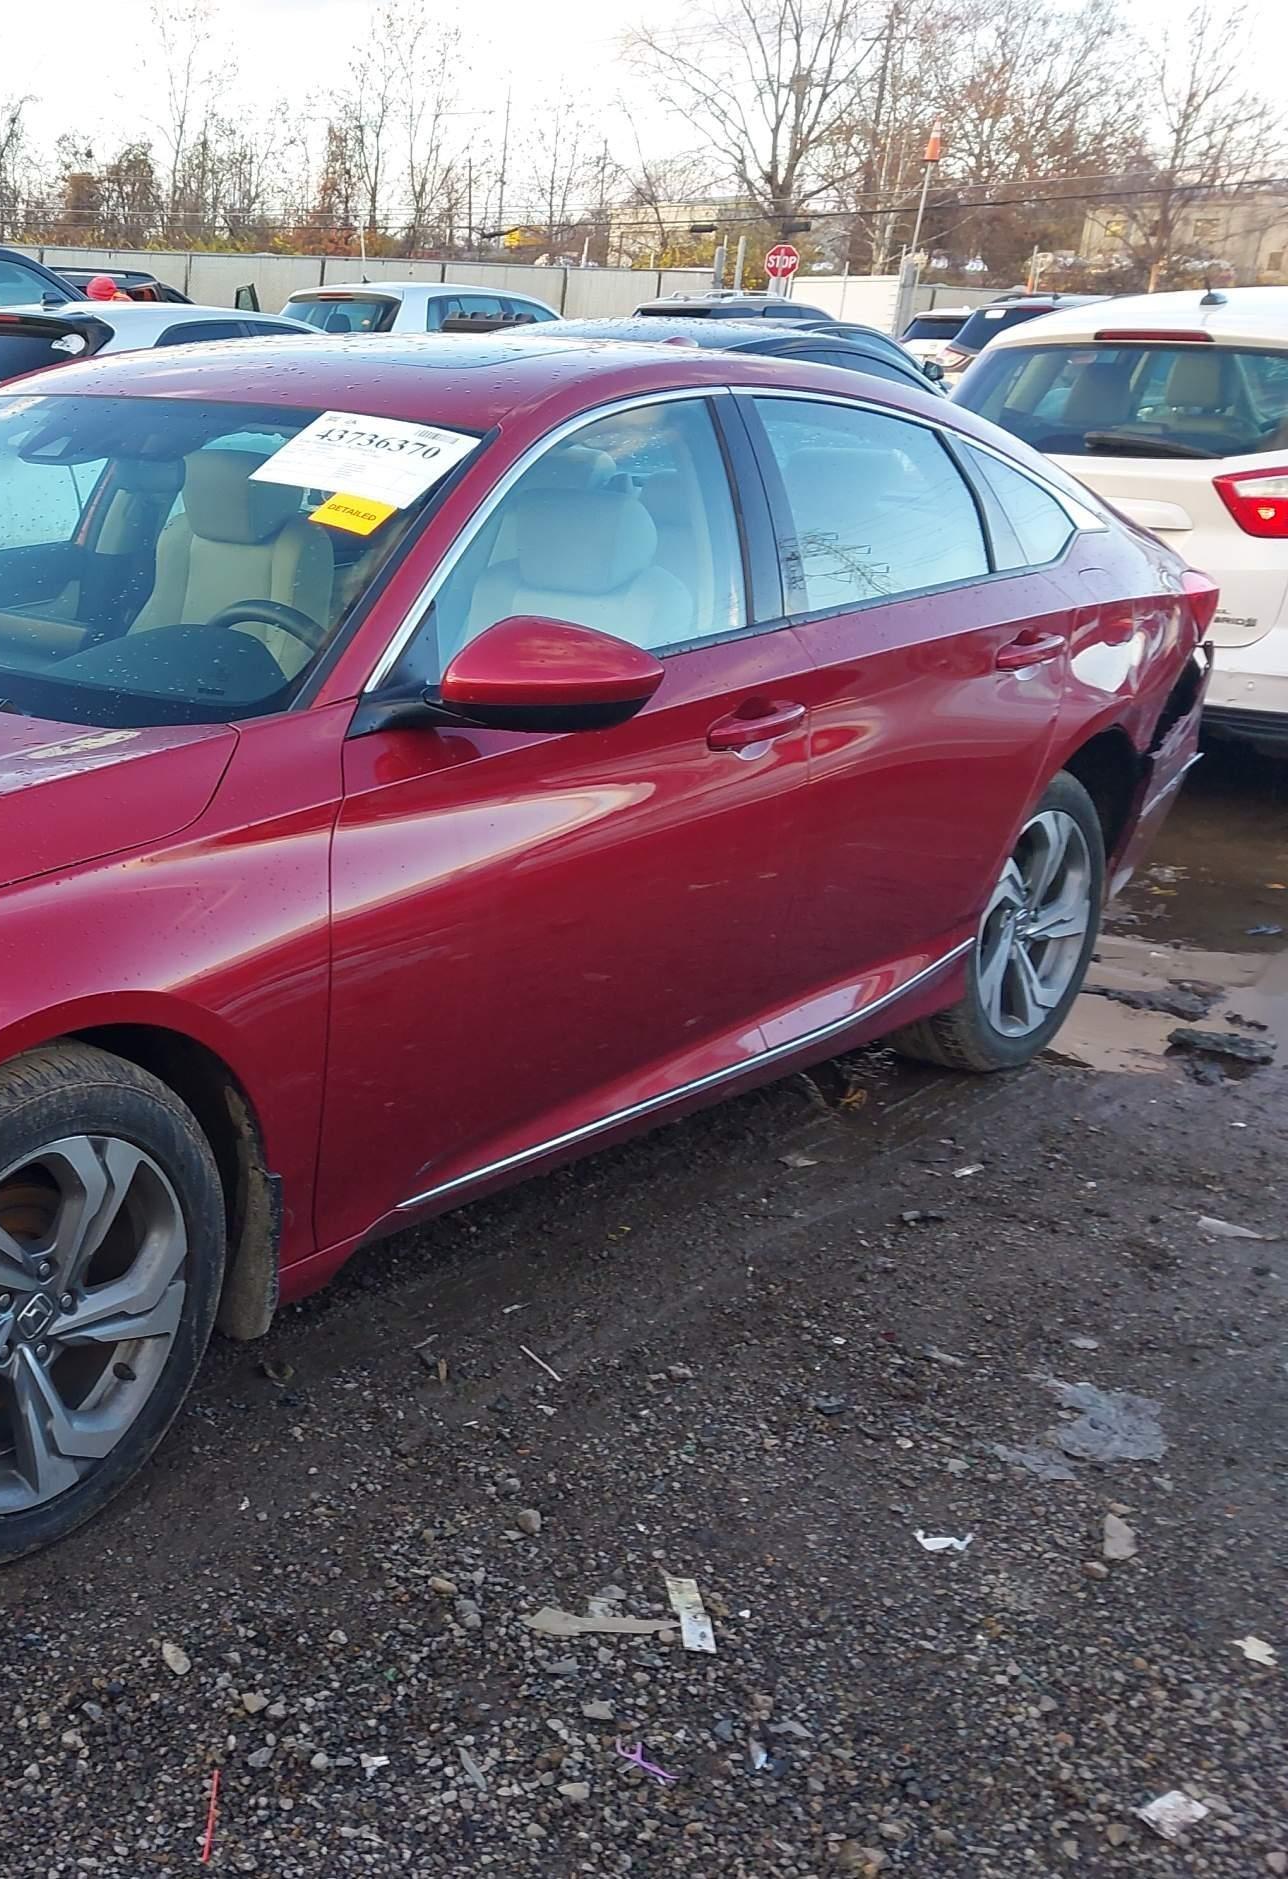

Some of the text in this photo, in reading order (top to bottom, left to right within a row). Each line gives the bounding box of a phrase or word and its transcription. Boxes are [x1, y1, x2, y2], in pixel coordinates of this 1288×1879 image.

[767, 254, 797, 269] STOP
[315, 428, 441, 460] 43736370
[327, 503, 377, 521] DETAILED
